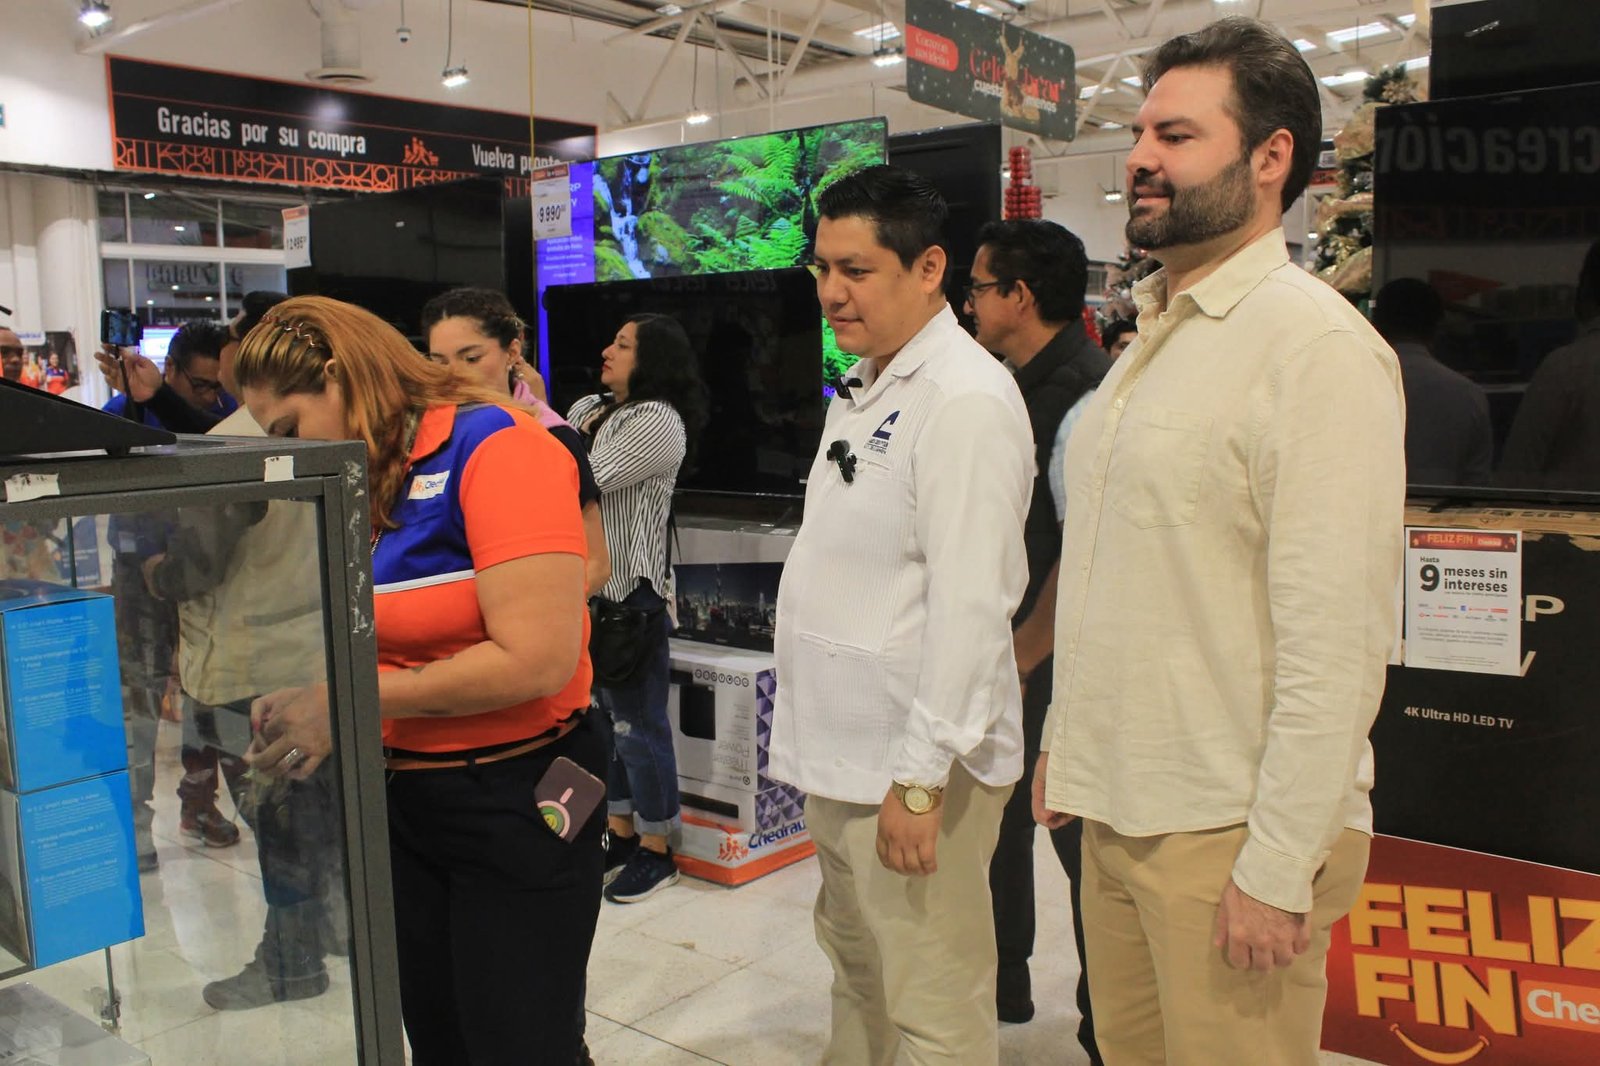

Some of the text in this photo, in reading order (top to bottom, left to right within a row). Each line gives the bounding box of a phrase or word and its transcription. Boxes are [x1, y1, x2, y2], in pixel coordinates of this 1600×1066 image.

[157, 107, 367, 157] Gracias por su compra
[472, 143, 515, 169] Vuelva
[1426, 533, 1455, 544] FELIZ
[1456, 535, 1474, 544] FIN
[1420, 556, 1440, 564] Hasta
[1420, 564, 1440, 592] 9
[1444, 567, 1508, 579] meses sin
[1444, 578, 1508, 593] intereses
[1404, 705, 1514, 729] 4K Ultra HD LED TV
[1349, 882, 1600, 971] FELIZ
[1353, 953, 1600, 1037] FIN Che
